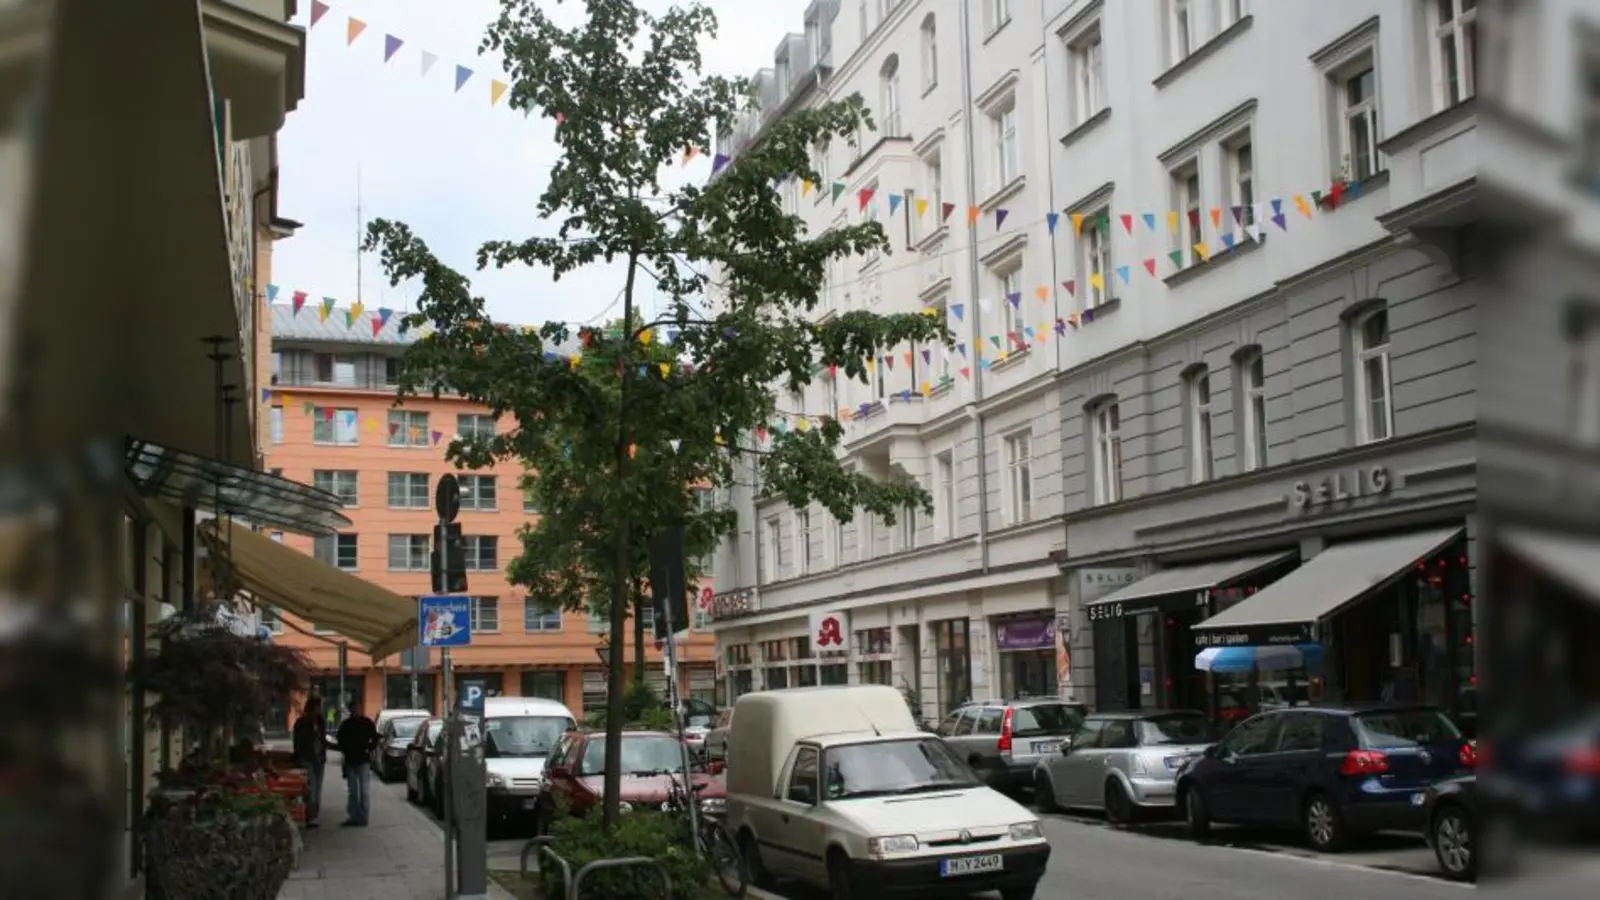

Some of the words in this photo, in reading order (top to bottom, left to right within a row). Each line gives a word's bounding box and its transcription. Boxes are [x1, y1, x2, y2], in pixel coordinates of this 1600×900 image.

[1294, 465, 1387, 507] SELIG
[1086, 573, 1133, 583] SELIG
[1089, 602, 1123, 620] SELIG
[466, 686, 482, 706] P
[974, 856, 999, 869] 2449
